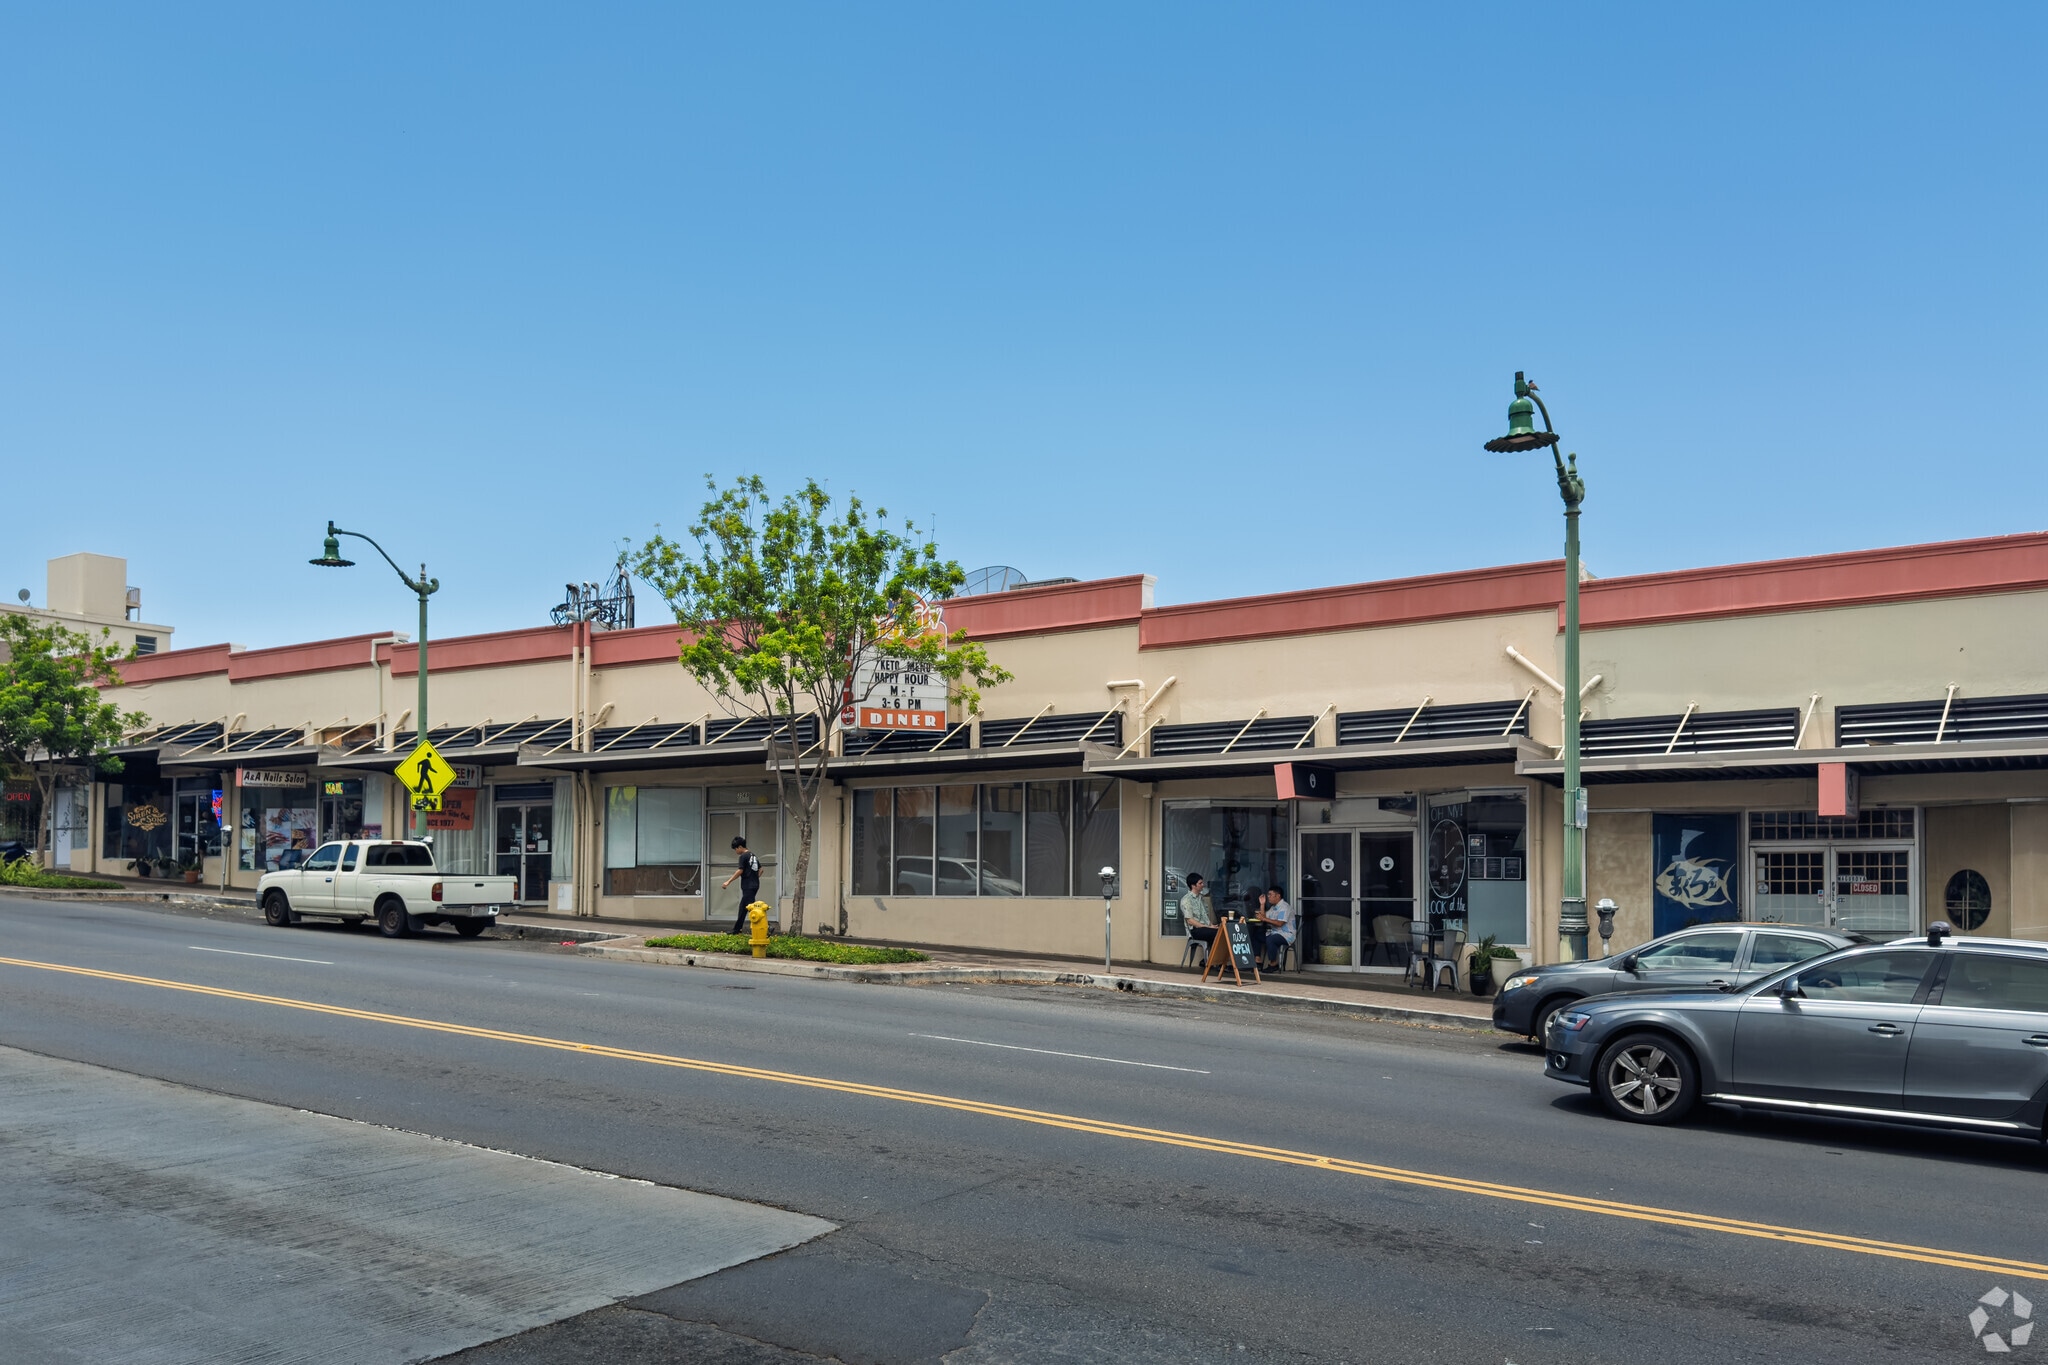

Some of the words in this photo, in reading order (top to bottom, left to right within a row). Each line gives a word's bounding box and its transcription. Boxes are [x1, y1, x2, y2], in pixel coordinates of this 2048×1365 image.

[880, 660, 900, 671] KETO
[907, 661, 931, 673] MENU
[874, 672, 899, 684] HAPPY
[904, 674, 929, 686] HOUR
[890, 685, 898, 696] M
[910, 686, 915, 697] F
[908, 698, 922, 710] PM
[869, 712, 937, 727] DINER
[243, 771, 261, 782] A&A
[263, 772, 283, 783] Nails
[284, 773, 305, 784] Salon
[6, 792, 31, 801] OPEN
[1430, 807, 1444, 821] OH
[1852, 883, 1878, 893] CLOSED
[1232, 943, 1251, 955] OPEN
